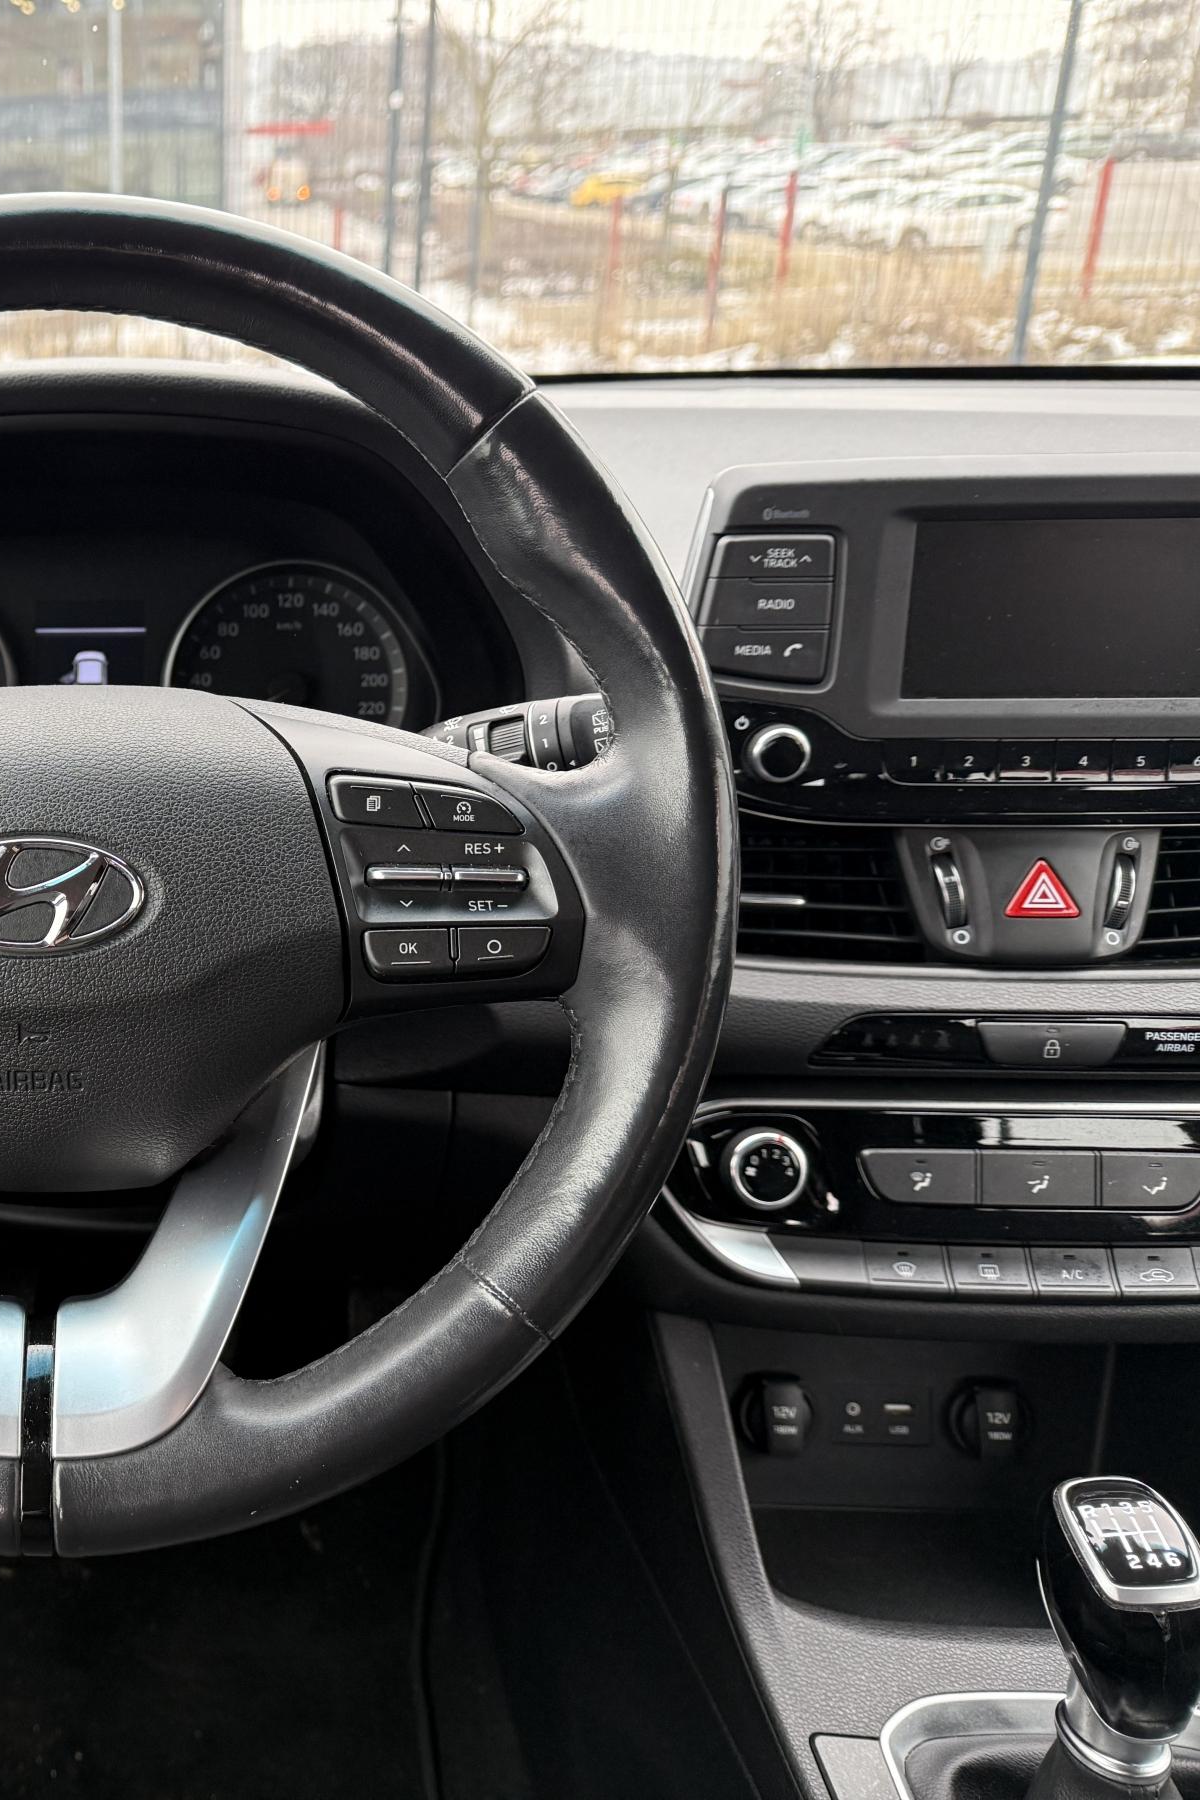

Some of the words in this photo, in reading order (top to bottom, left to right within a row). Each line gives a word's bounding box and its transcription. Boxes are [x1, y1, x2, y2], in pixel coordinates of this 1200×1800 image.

[766, 548, 796, 558] SEEK
[763, 558, 798, 568] TRACK
[278, 593, 304, 608] 120
[757, 599, 795, 610] RADIO
[243, 604, 269, 618] 100
[312, 602, 339, 617] 140
[217, 622, 239, 637] 80
[337, 622, 364, 637] 160
[201, 646, 221, 660] 60
[354, 646, 380, 661] 180
[734, 645, 772, 656] MEDIA
[361, 673, 388, 688] 200
[358, 701, 385, 715] 220
[539, 714, 549, 725] 2
[542, 738, 549, 749] 1
[910, 756, 917, 767] 1
[964, 756, 974, 767] 2
[1021, 756, 1031, 767] 3
[1078, 756, 1088, 767] 4
[1136, 756, 1146, 767] 5
[453, 814, 475, 822] MODE
[399, 943, 418, 954] OK
[1155, 1043, 1195, 1052] AIRBAG
[1061, 1269, 1083, 1280] A/C
[772, 1406, 797, 1419] 12V
[986, 1412, 1011, 1424] 12V
[1125, 1554, 1143, 1569] 2
[1146, 1553, 1162, 1568] 4
[1165, 1552, 1181, 1567] 6
